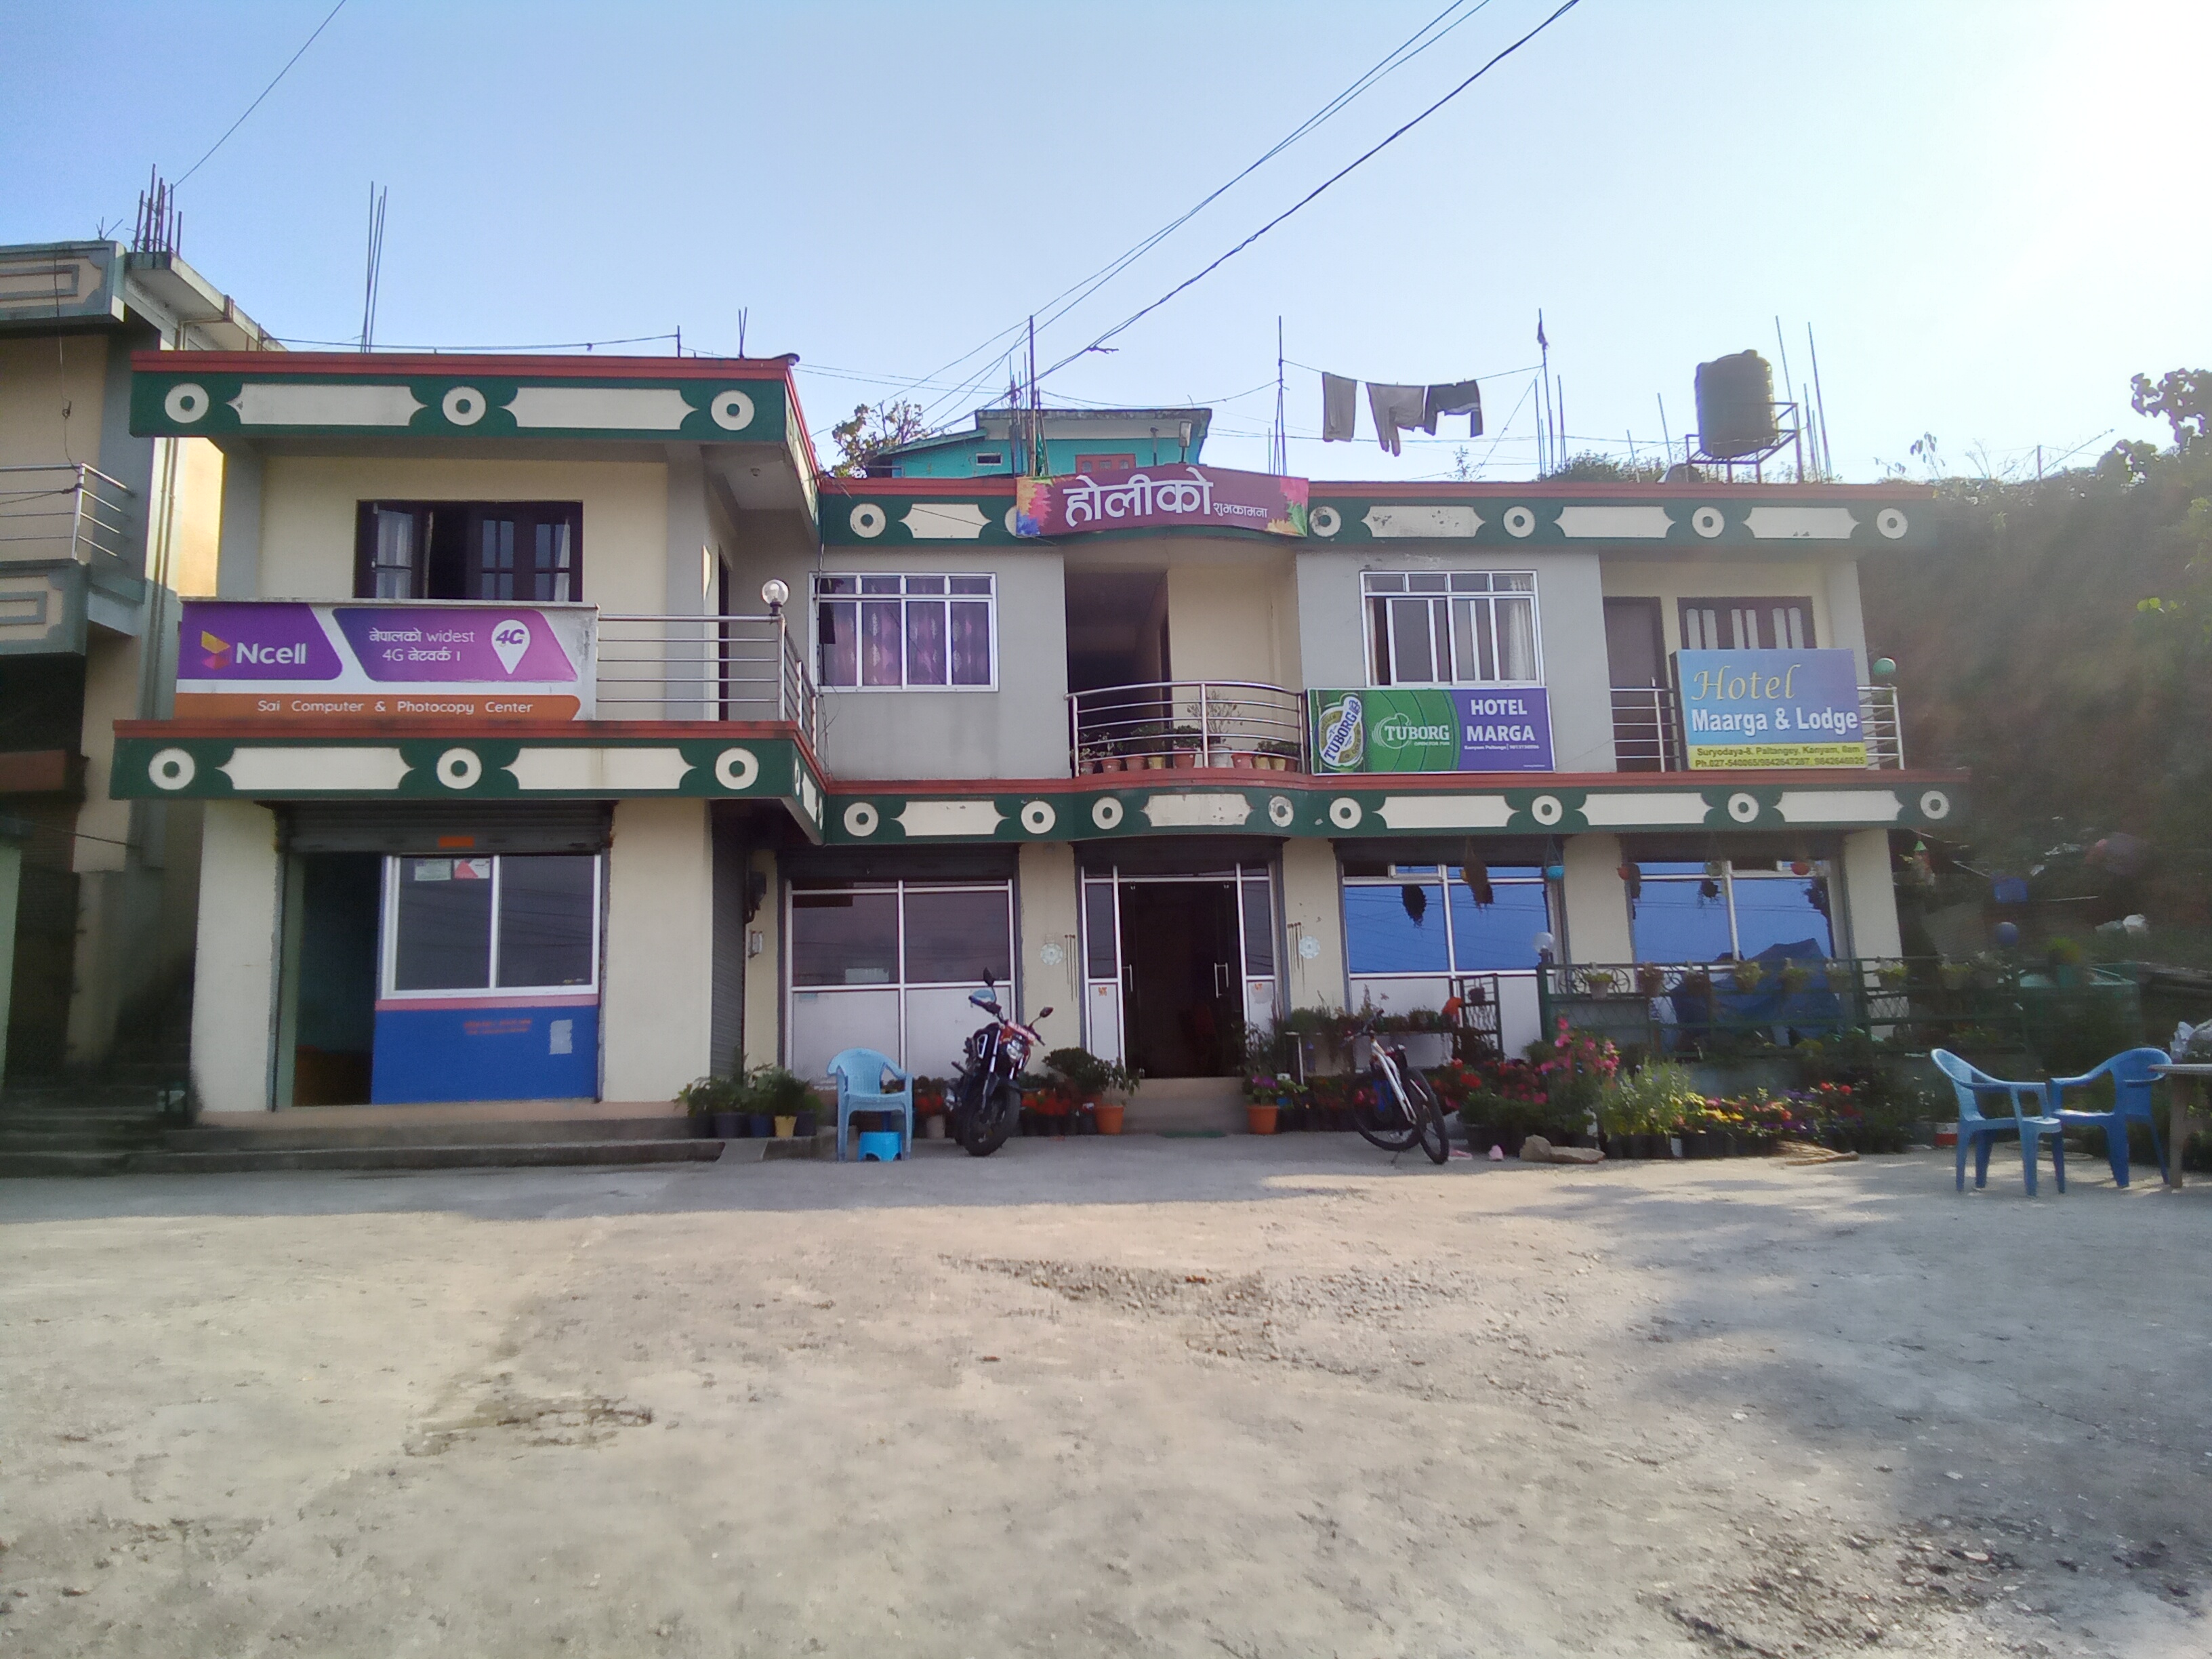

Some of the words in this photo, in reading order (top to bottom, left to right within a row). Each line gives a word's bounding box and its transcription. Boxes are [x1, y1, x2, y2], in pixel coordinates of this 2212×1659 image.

[1063, 467, 1214, 527] होलीको
[1213, 502, 1268, 518] शुभकामना
[369, 628, 422, 642] नेपालको
[426, 630, 475, 642] widest
[495, 629, 525, 645] 4G
[236, 642, 306, 665] Ncell
[382, 649, 404, 661] 4G
[407, 647, 452, 661] नेटवर्क
[1691, 664, 1801, 701] Hotel
[257, 700, 281, 712] Sai
[291, 700, 364, 715] Computer
[374, 701, 387, 712] &
[397, 700, 474, 716] Photocopy
[485, 700, 533, 713] Center
[1471, 699, 1528, 716] HOTEL
[1692, 709, 1768, 737] Maarga
[1775, 708, 1791, 731] &
[1796, 707, 1858, 735] Lodge
[1324, 712, 1357, 761] TUBORG
[1385, 725, 1450, 741] TUBORG
[1466, 725, 1535, 742] MARGA
